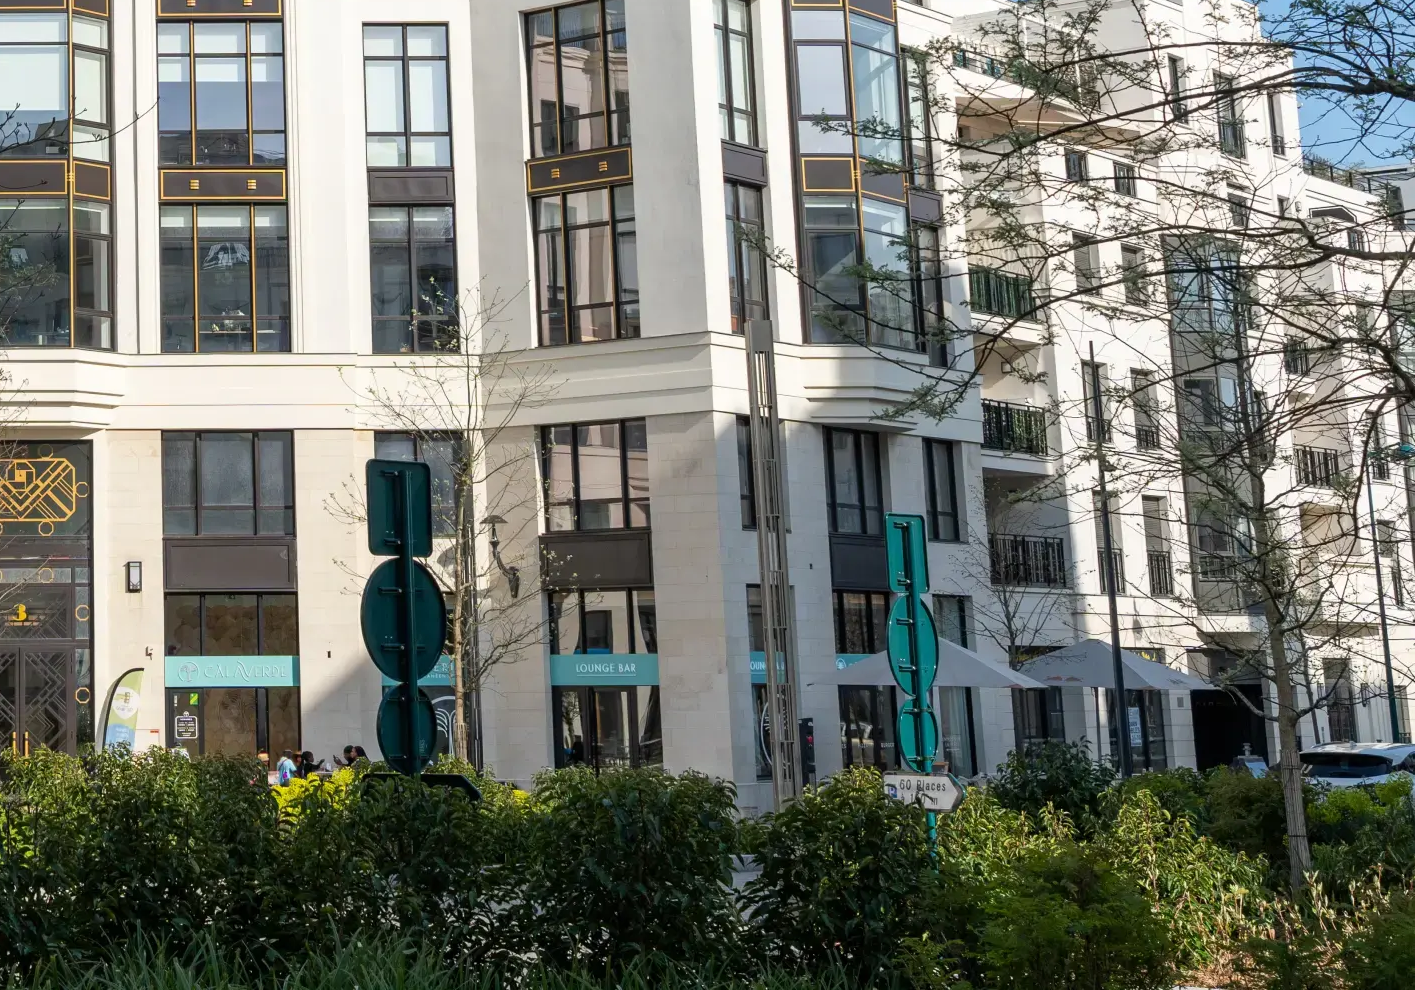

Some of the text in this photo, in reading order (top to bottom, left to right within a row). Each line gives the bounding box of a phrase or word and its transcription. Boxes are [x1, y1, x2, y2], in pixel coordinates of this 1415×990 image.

[13, 603, 27, 621] 3
[575, 663, 636, 673] LOUNGE BAR
[899, 779, 946, 792] 60 Places
